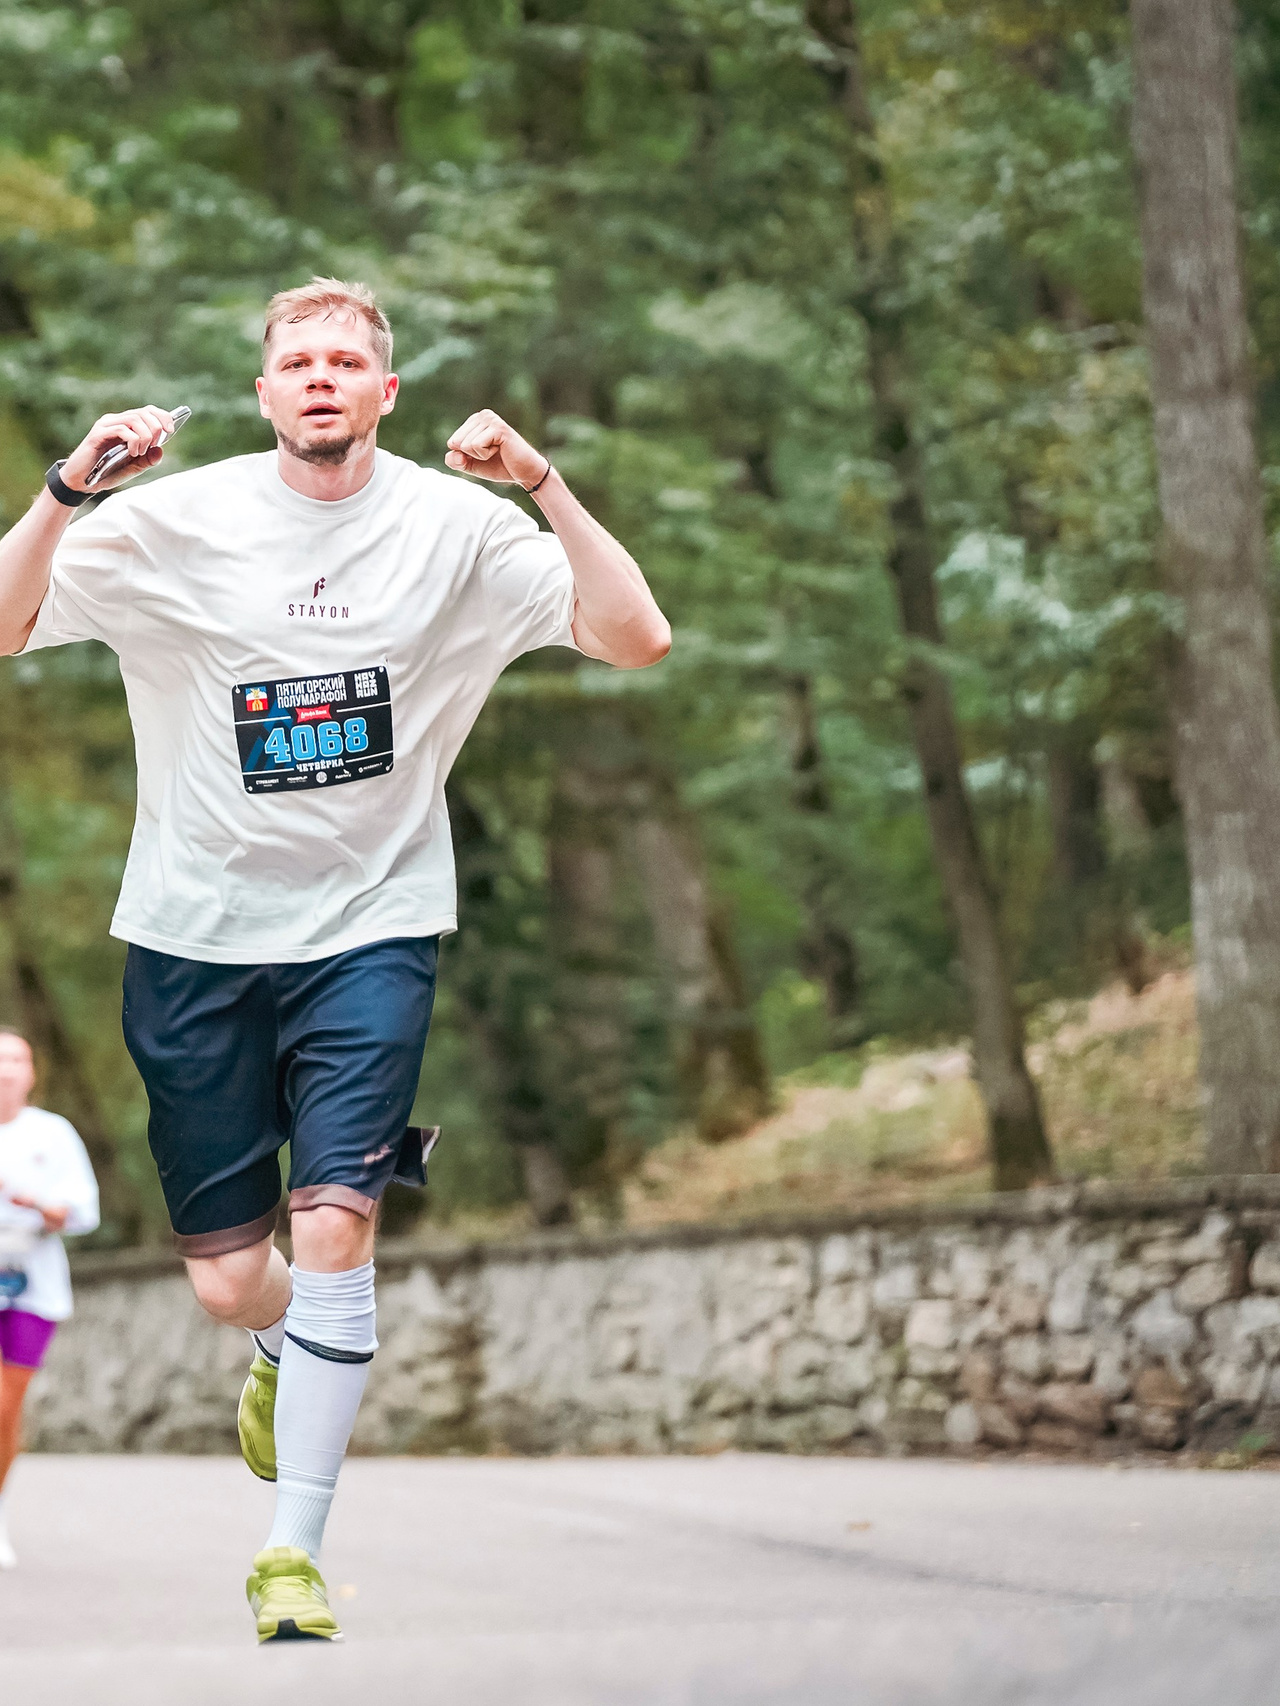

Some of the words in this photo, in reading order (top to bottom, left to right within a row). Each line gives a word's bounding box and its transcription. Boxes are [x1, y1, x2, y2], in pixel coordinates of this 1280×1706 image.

[288, 603, 349, 618] STAYON
[275, 674, 346, 697] ПЯТИГОРСКИЙ
[356, 688, 379, 699] RUN
[277, 689, 348, 709] ПОЛУМАРАФОН
[264, 717, 369, 763] 4068
[296, 758, 345, 772] ЧЕТВЁРКА
